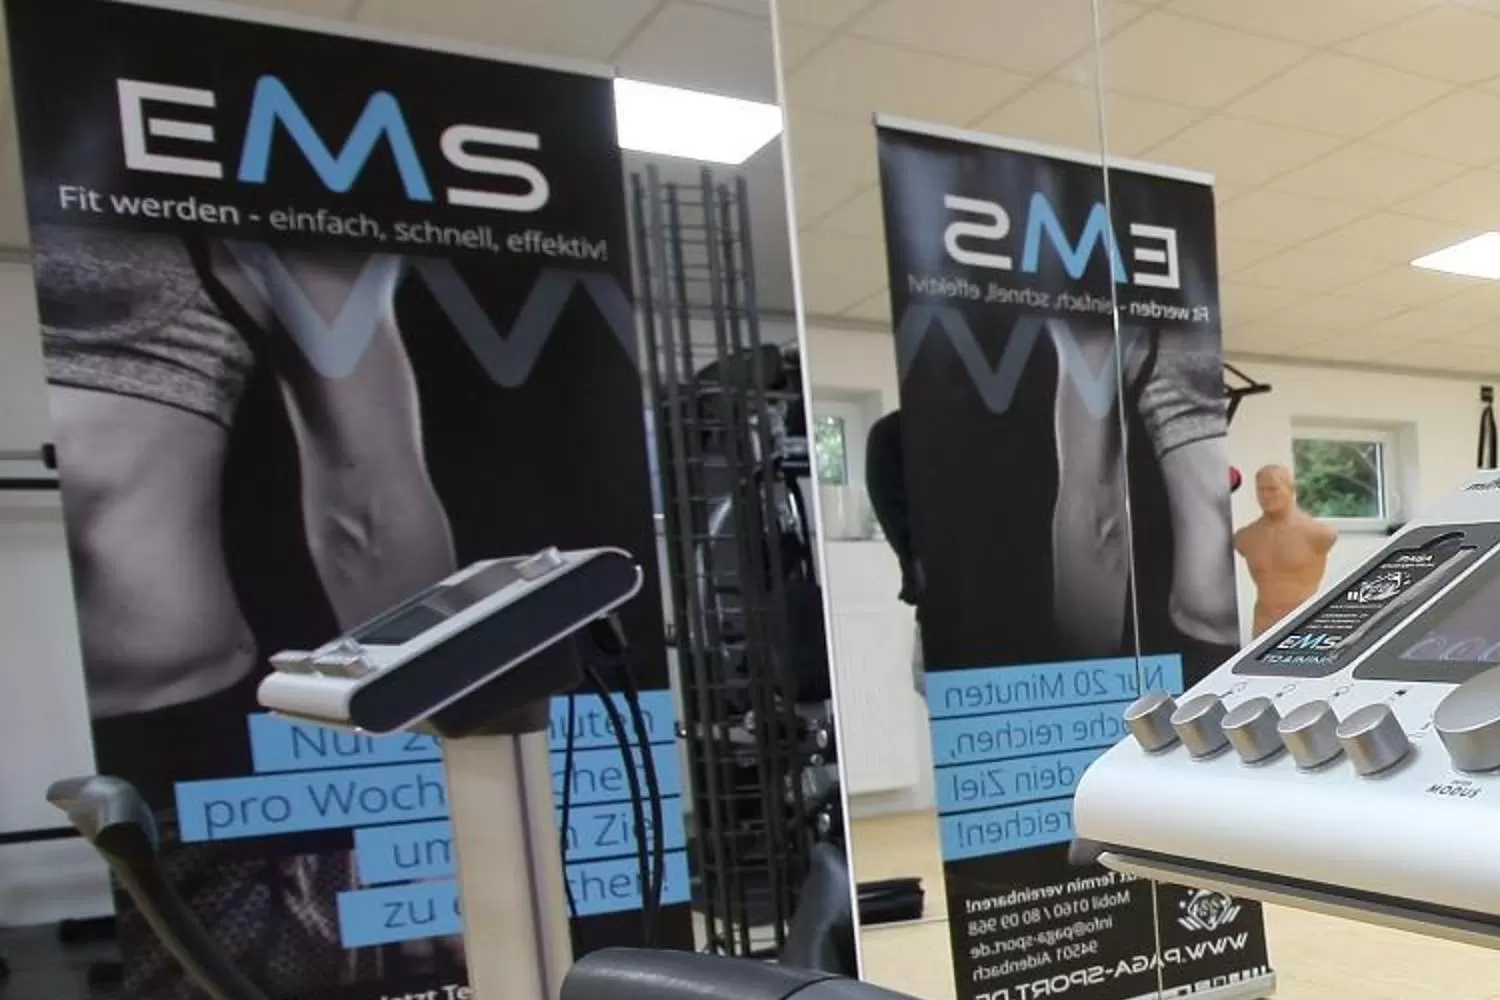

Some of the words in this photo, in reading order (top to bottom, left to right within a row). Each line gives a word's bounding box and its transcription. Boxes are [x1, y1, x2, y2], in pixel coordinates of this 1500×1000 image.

[117, 75, 550, 213] EMS
[59, 184, 104, 213] Fit
[110, 194, 240, 225] werden
[268, 206, 386, 241] einfach,
[394, 219, 499, 253] schnell,
[507, 229, 608, 261] effektiv!
[1277, 633, 1342, 649] EMS
[204, 793, 291, 831] pro
[307, 774, 446, 818] Woch
[1425, 783, 1482, 798] MODUS
[383, 897, 436, 929] zu
